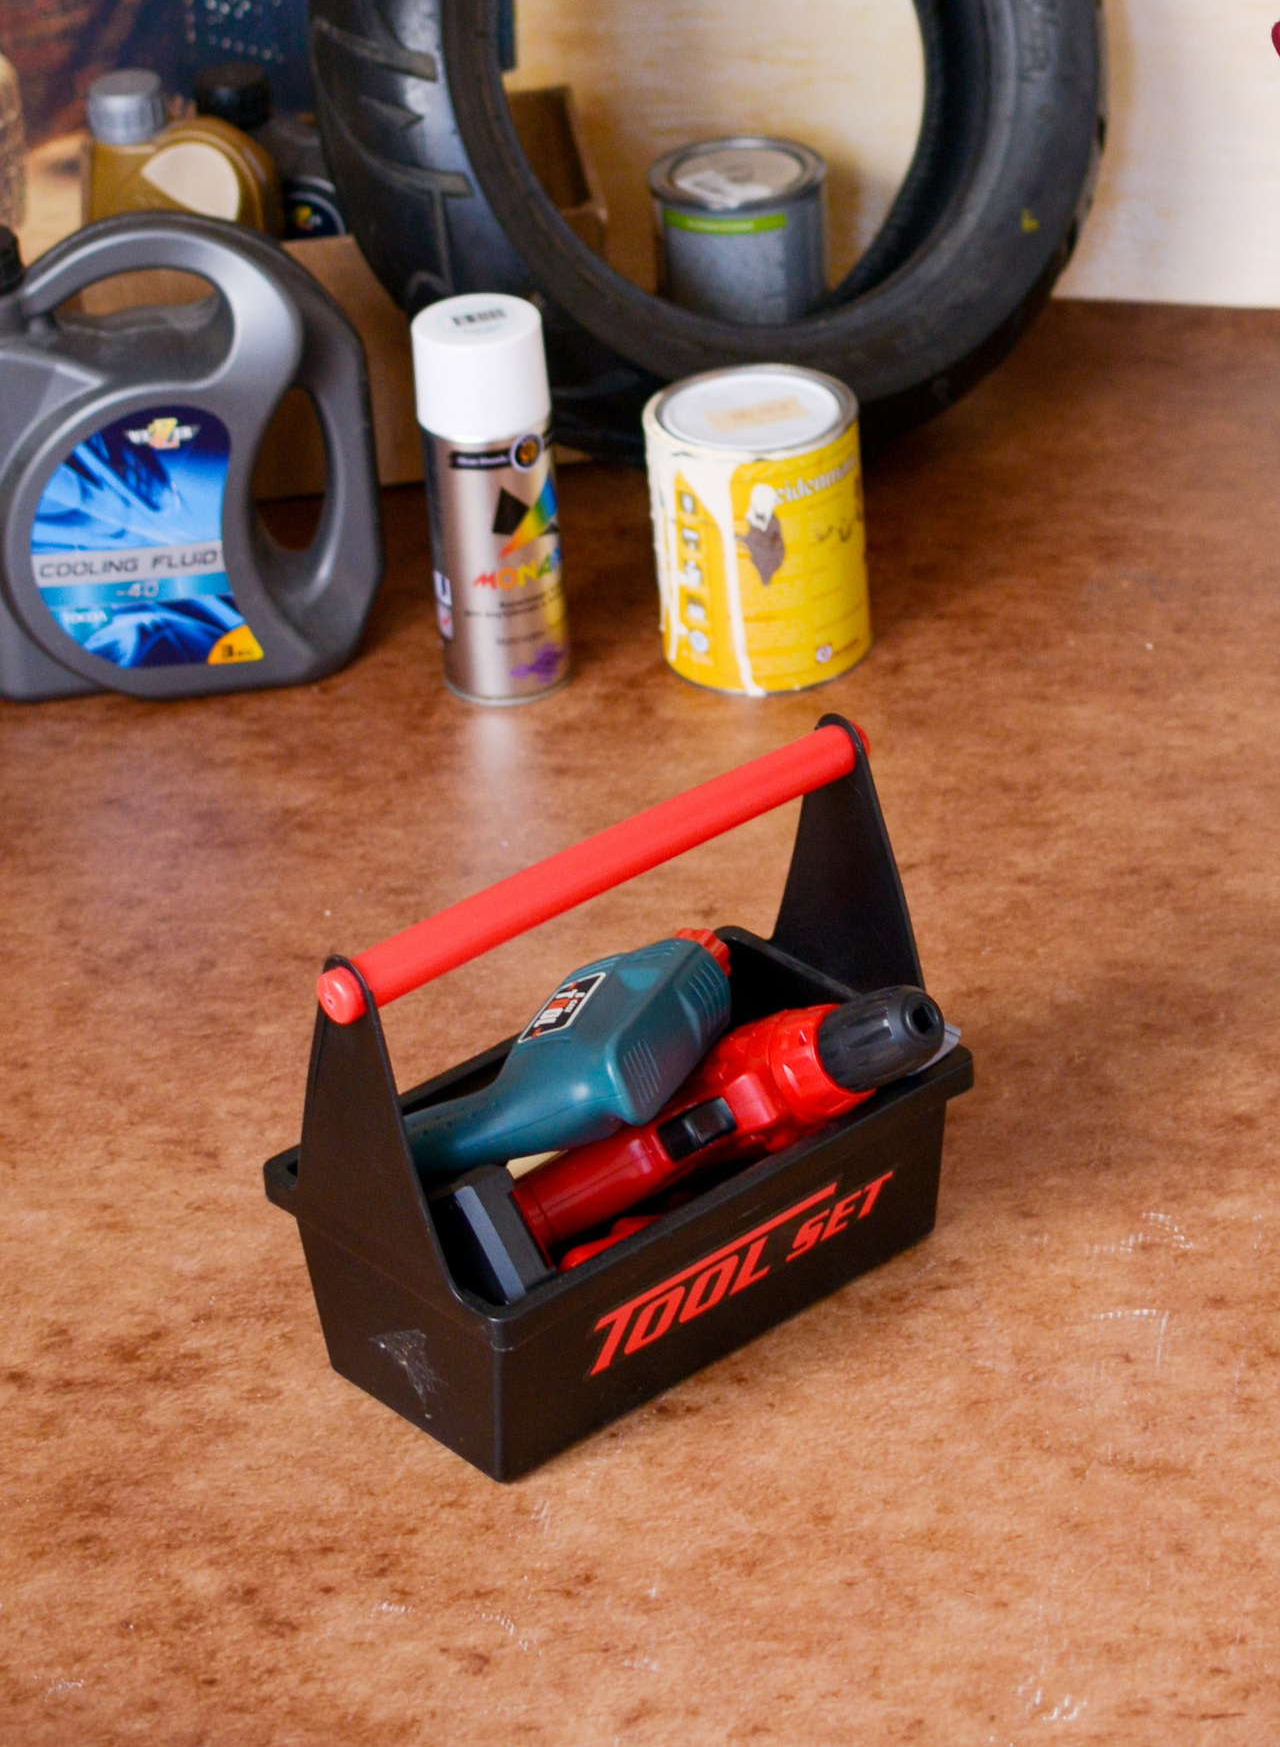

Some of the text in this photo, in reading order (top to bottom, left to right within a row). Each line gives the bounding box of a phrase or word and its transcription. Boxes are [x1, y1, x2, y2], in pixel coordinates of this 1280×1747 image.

[39, 549, 219, 578] COOLING FLUID
[115, 580, 160, 598] -40
[590, 1172, 893, 1375] TOOL SET
